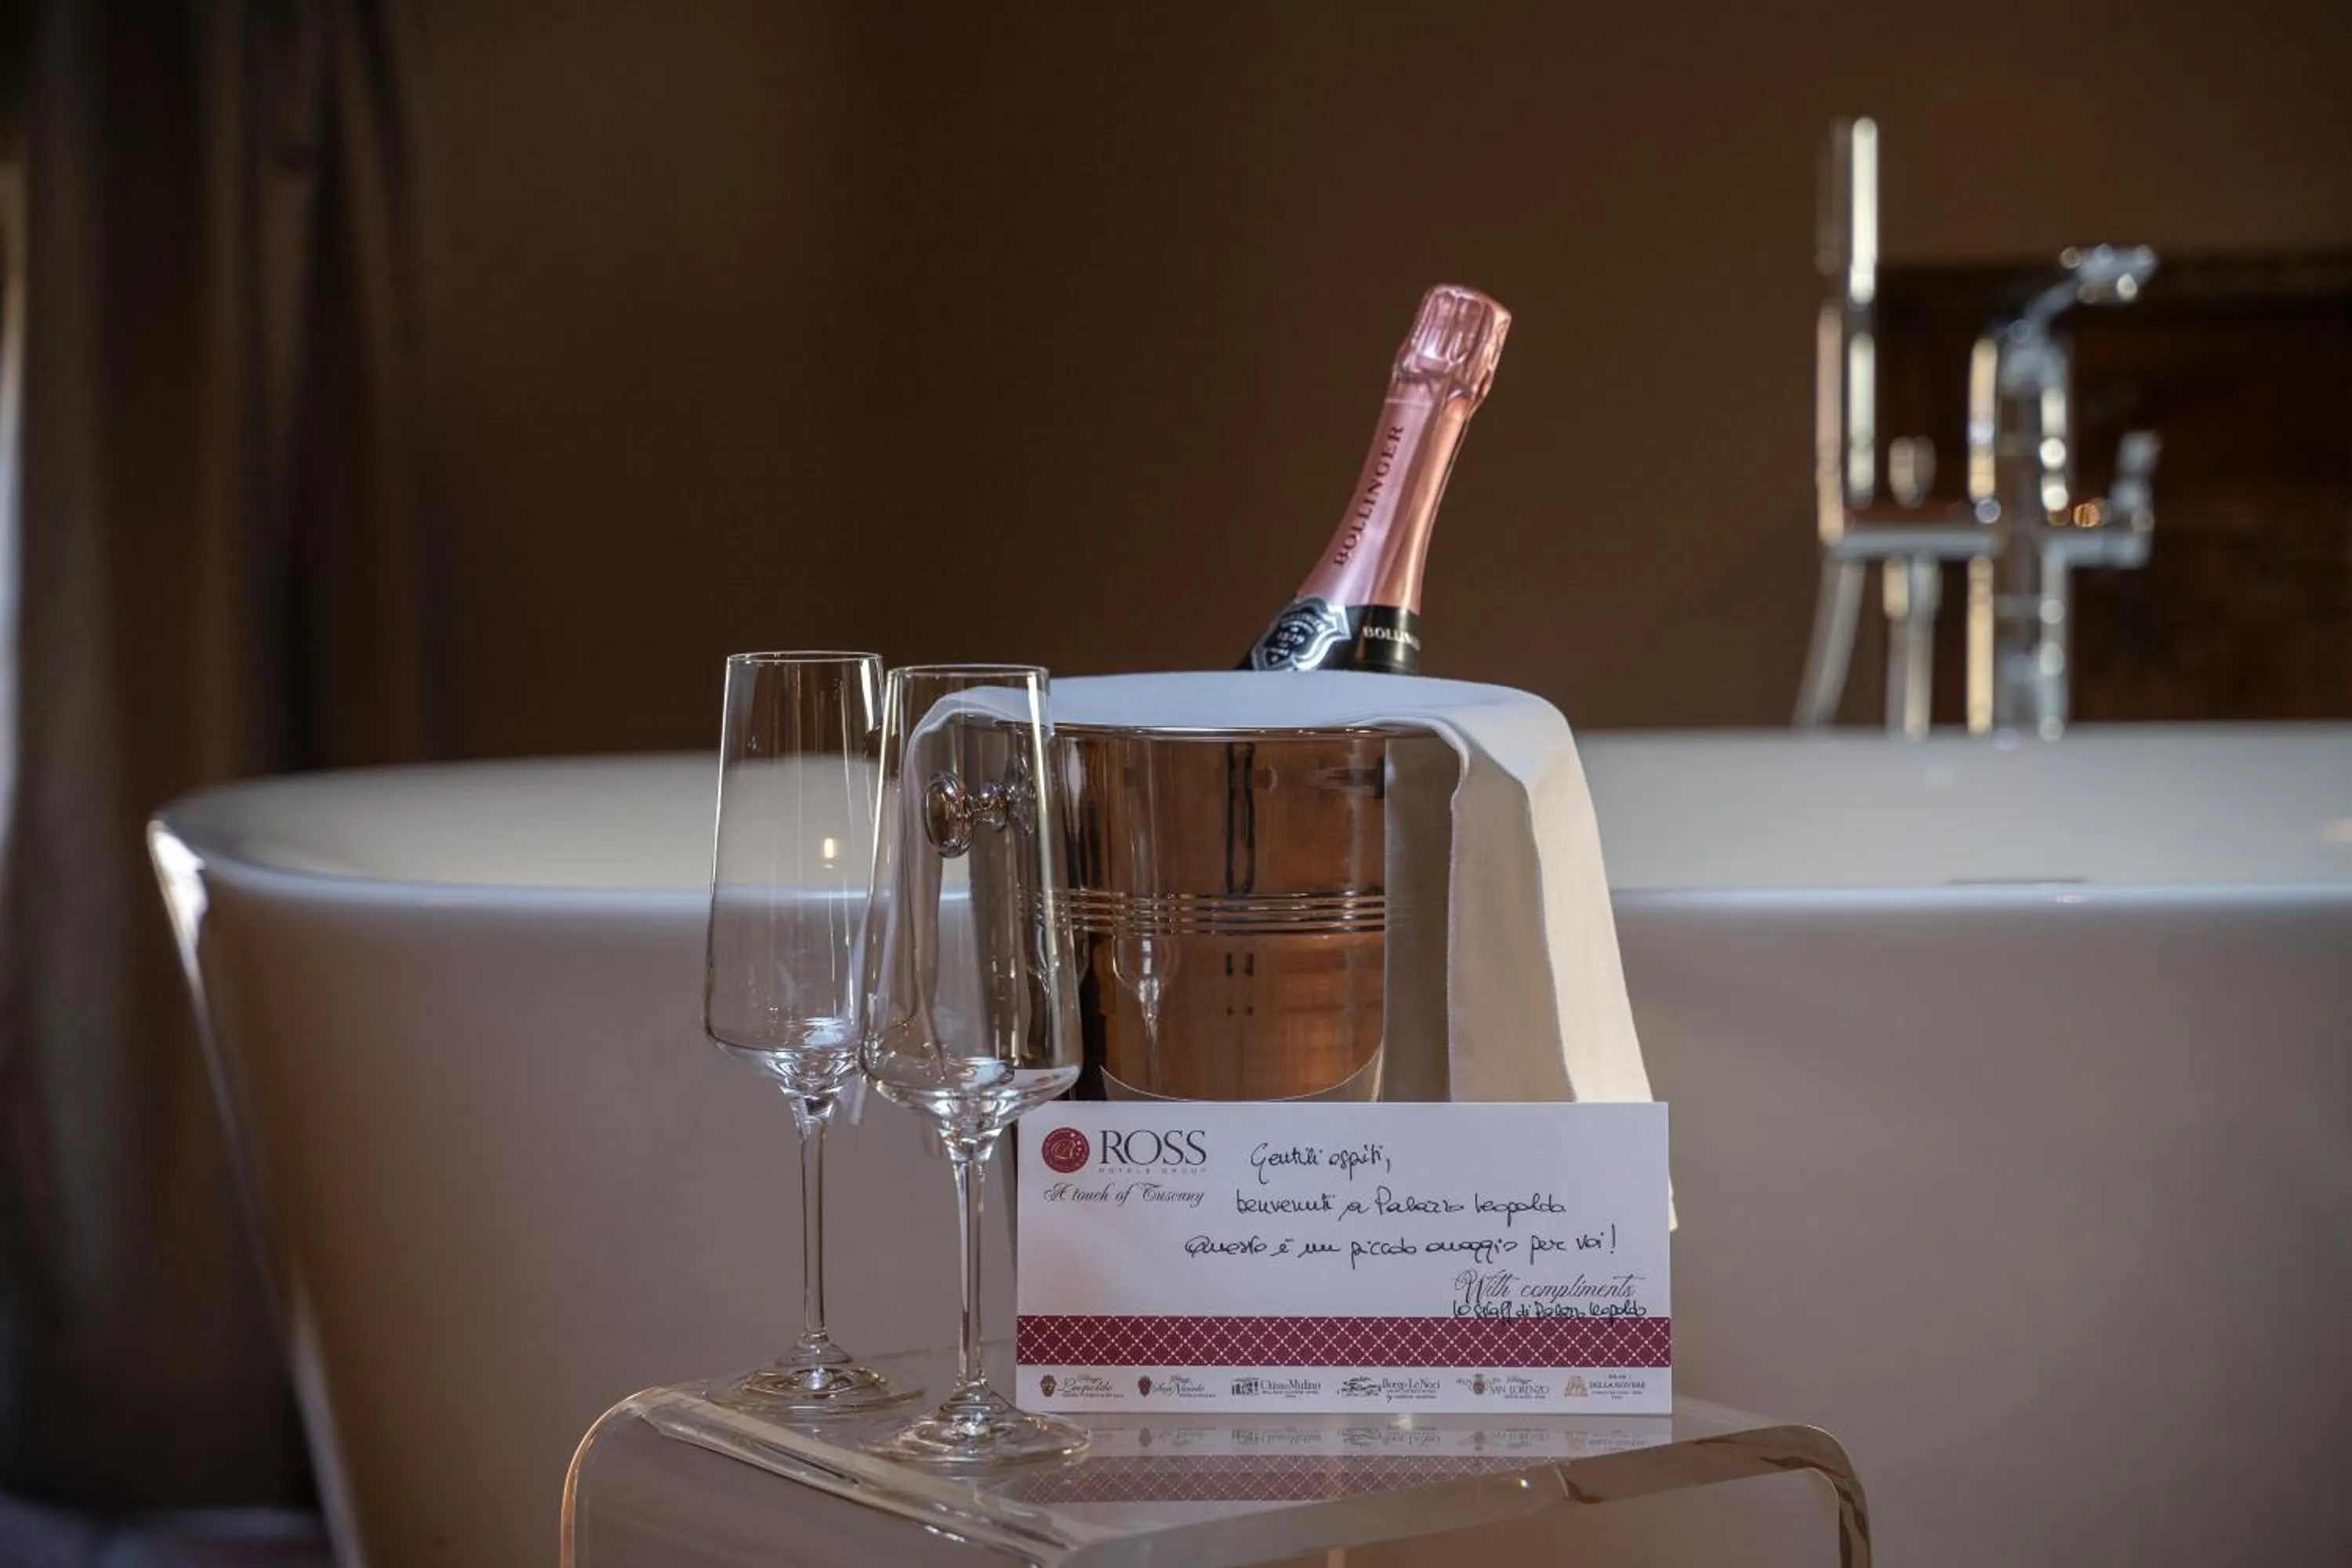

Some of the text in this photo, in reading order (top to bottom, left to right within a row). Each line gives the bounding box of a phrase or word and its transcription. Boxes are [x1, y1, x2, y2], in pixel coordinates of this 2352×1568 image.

[1334, 425, 1405, 568] BOLLINGER
[1099, 1129, 1207, 1166] ROSS
[1250, 1142, 1323, 1185] Gentili
[1072, 1178, 1115, 1202] touch
[1116, 1182, 1138, 1206] of
[1136, 1181, 1205, 1208] Tuscany
[1236, 1189, 1335, 1214] benvenuti
[1530, 1235, 1566, 1265] per
[1454, 1269, 1646, 1304] With compliments
